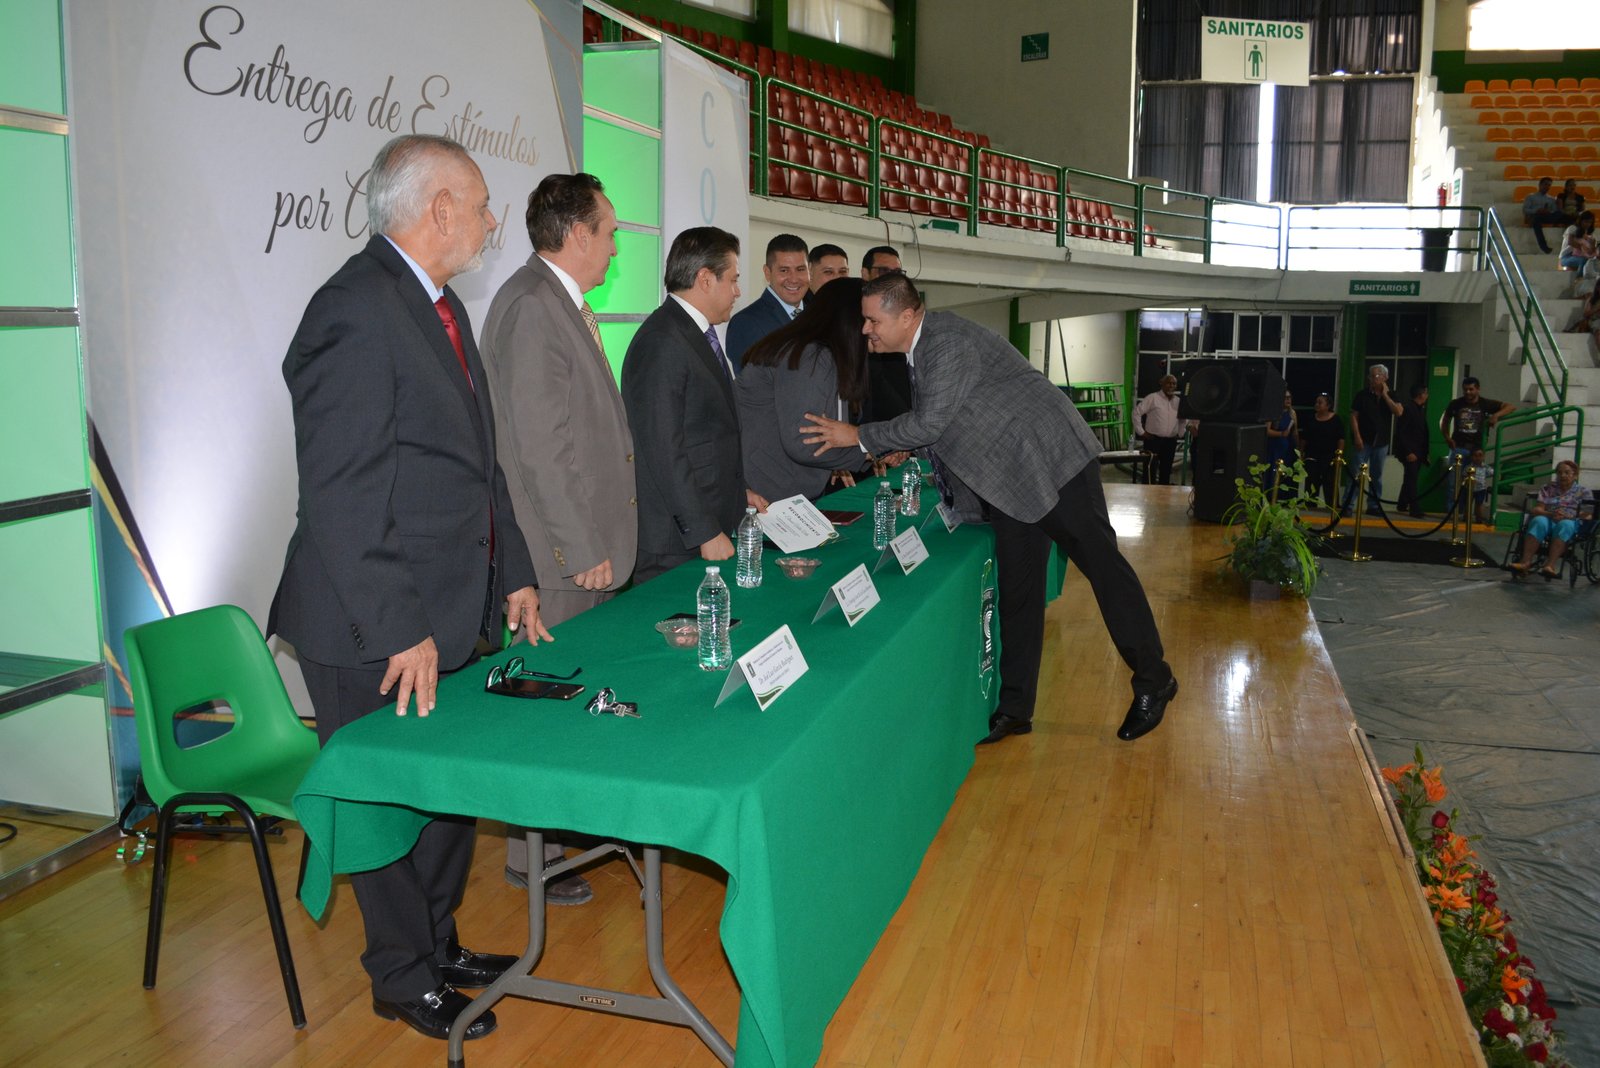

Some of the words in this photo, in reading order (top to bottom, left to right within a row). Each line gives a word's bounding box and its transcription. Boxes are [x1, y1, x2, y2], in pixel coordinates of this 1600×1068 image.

[1207, 19, 1304, 40] SANITARIOS
[183, 5, 357, 144] Entrega
[367, 75, 402, 133] de
[411, 74, 539, 167] Estímulos
[264, 187, 334, 254] por
[1353, 283, 1408, 292] SANITARIOS
[583, 996, 612, 1005] LIFETIME
